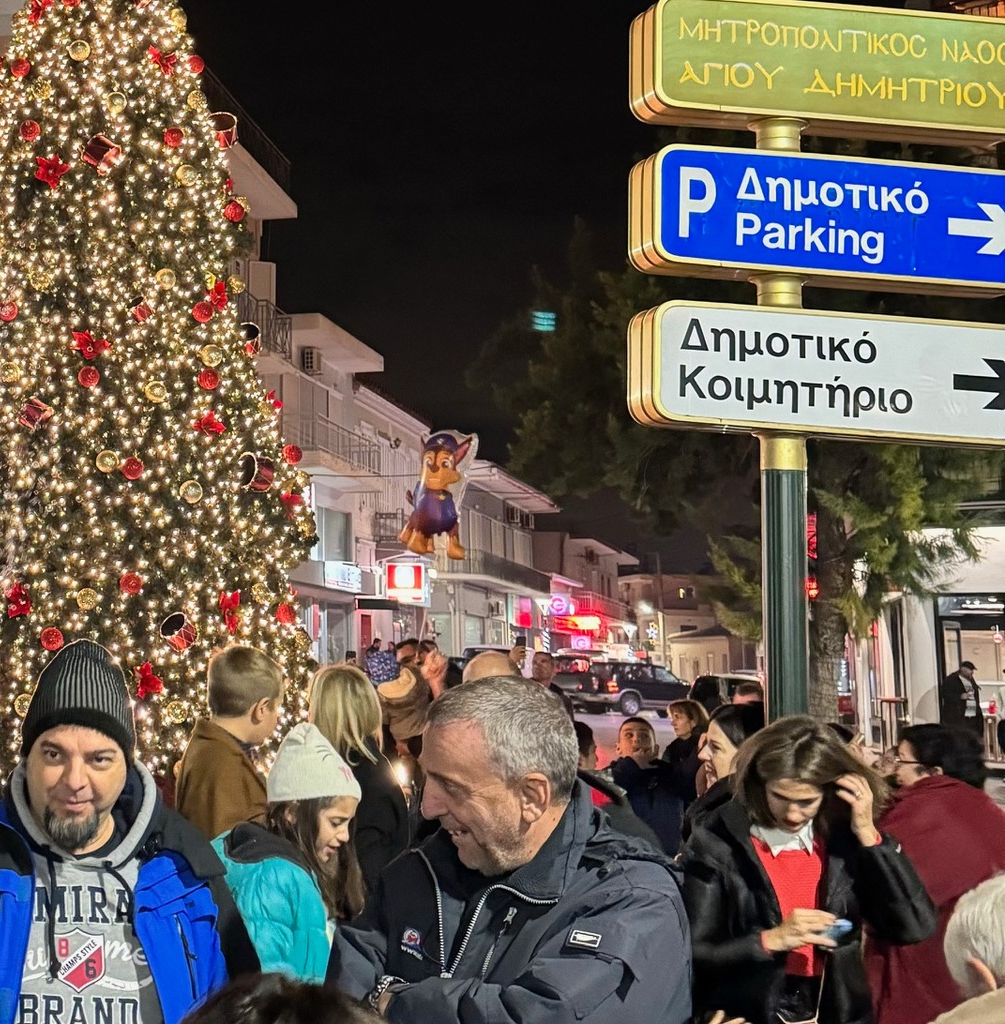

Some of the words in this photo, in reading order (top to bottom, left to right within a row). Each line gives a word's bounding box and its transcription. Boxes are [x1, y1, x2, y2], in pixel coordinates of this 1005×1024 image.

[679, 61, 784, 90] ΑΓΙΟΥ
[678, 166, 717, 238] P
[736, 167, 929, 215] Δημοτικό
[736, 212, 884, 264] Parking
[680, 318, 877, 364] Δημοτικό
[679, 364, 913, 418] Κοιμητήριο
[58, 938, 69, 958] 8
[81, 939, 98, 958] STYLE
[84, 958, 97, 979] 6
[17, 993, 140, 1024] BRAND
